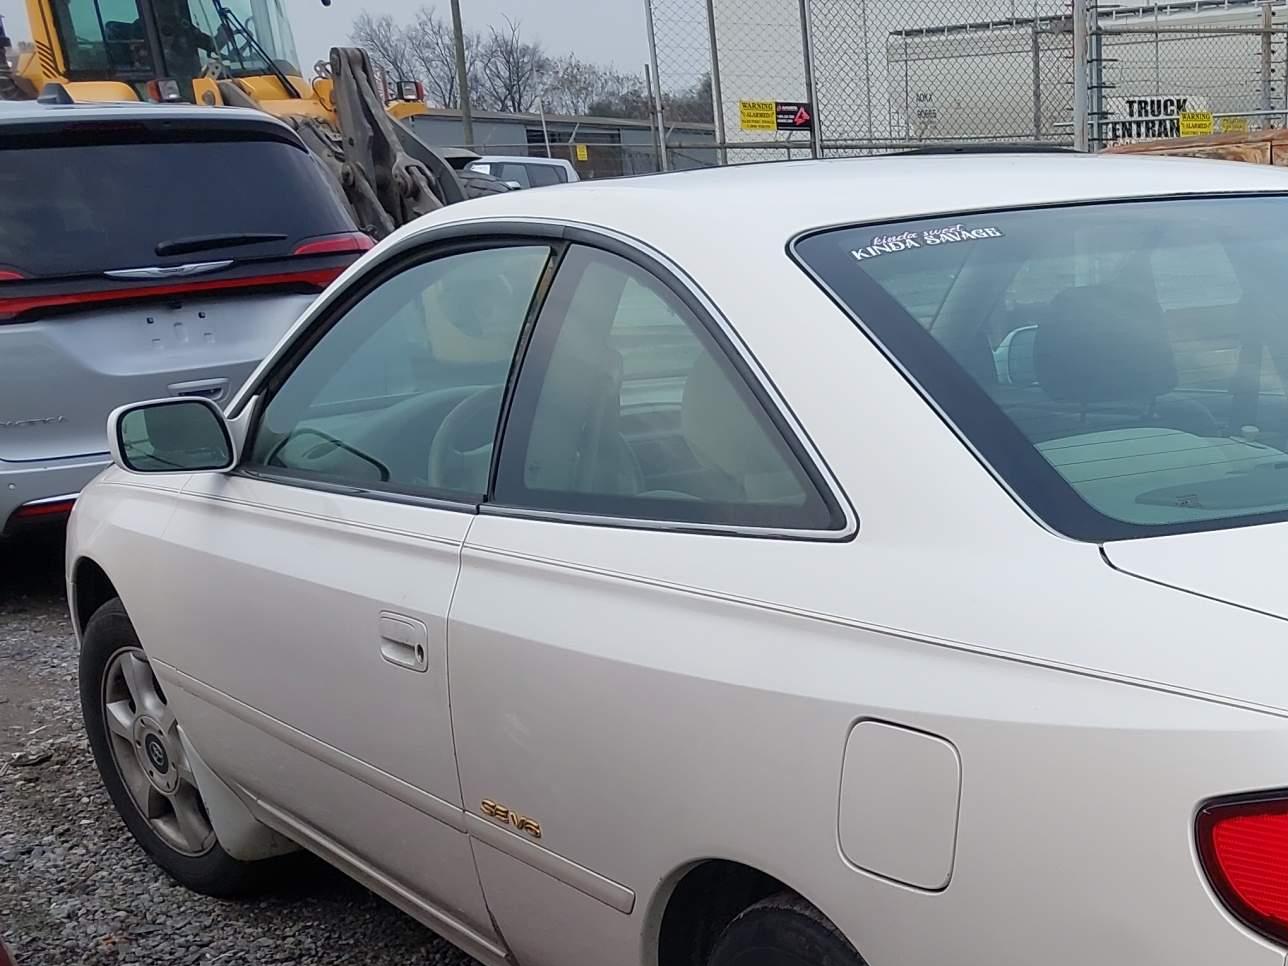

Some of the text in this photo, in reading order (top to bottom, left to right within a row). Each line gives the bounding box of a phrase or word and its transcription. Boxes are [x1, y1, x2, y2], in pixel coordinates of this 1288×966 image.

[1126, 99, 1187, 118] TRUCK
[851, 227, 1001, 261] KINDA SAVAGE
